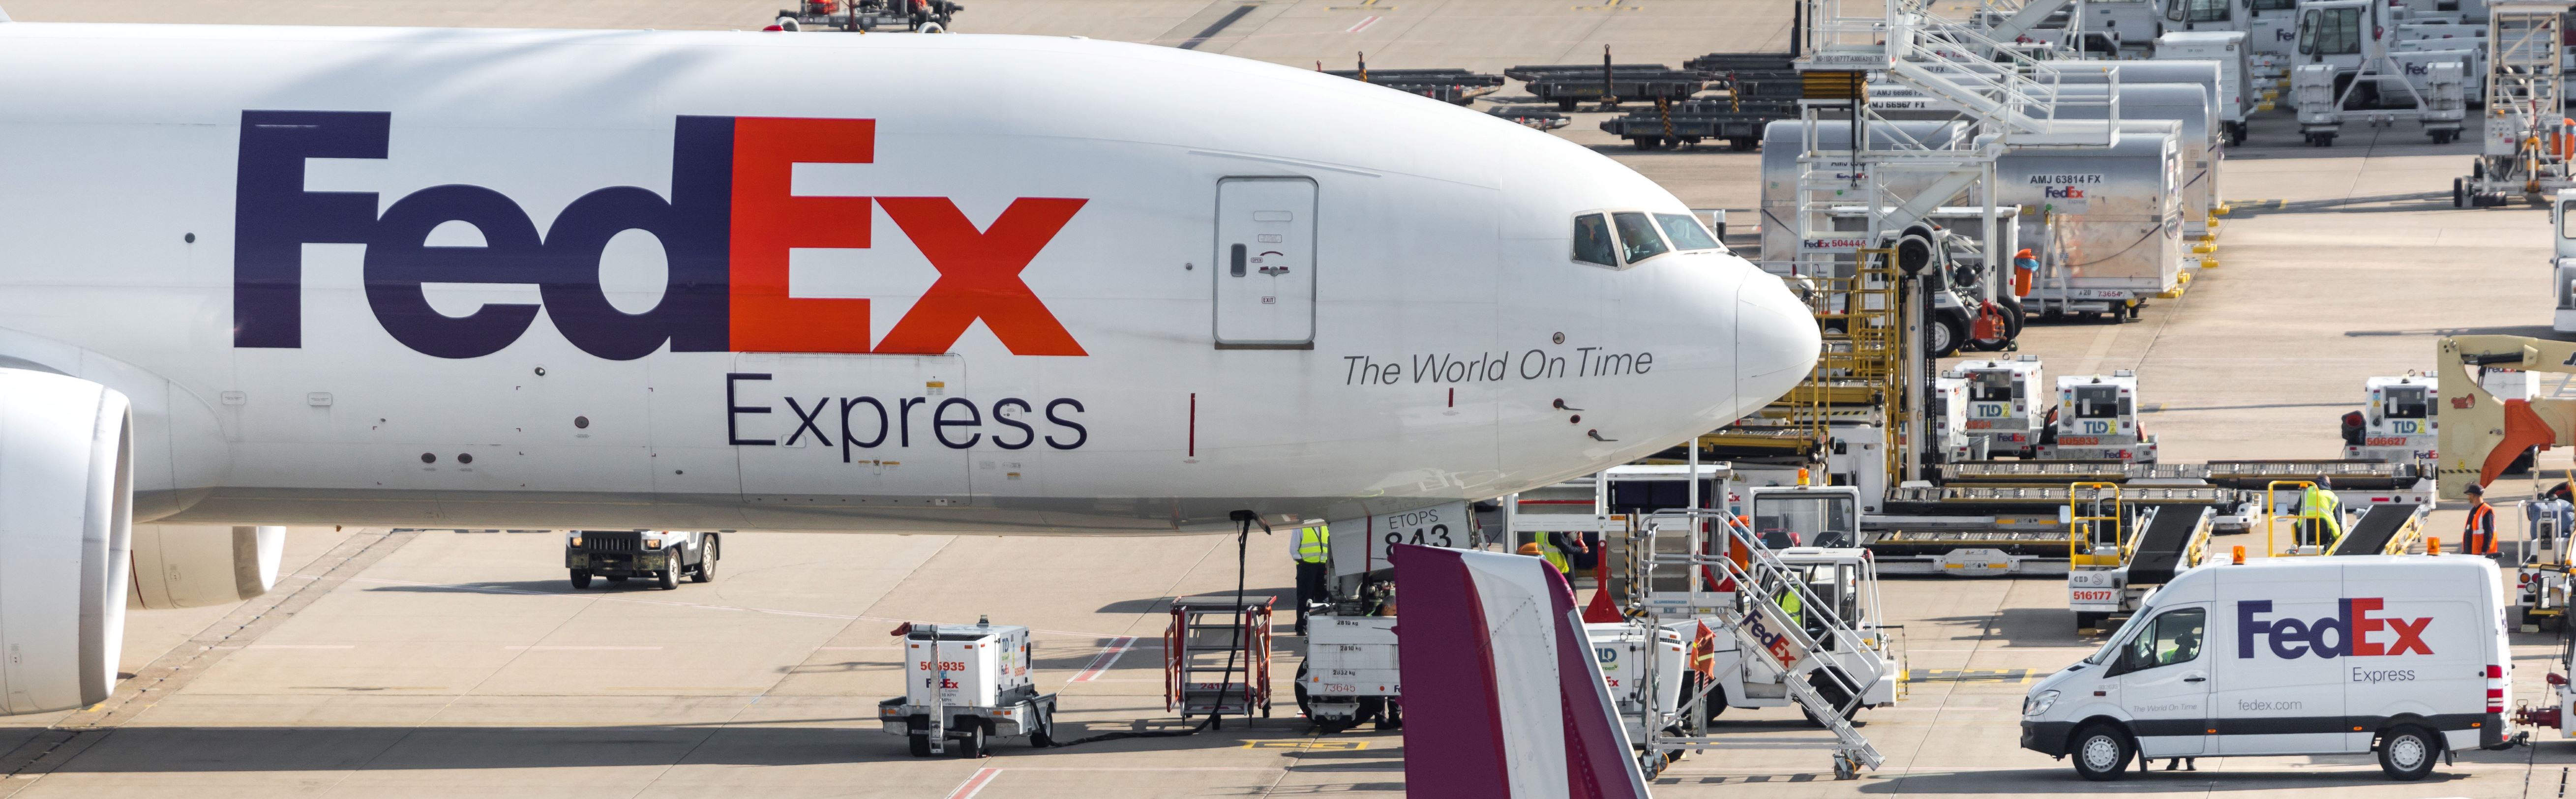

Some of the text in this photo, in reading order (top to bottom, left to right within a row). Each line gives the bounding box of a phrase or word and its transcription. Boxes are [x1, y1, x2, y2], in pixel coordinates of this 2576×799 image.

[2030, 175, 2101, 184] AMJ 63814 FX
[2045, 186, 2084, 198] FedEx
[234, 109, 1089, 361] FedEx
[1804, 239, 1830, 248] FedEx
[1344, 347, 1653, 385] The World On Time
[1978, 404, 2003, 417] TLD
[726, 373, 1088, 463] Express
[2084, 421, 2109, 434] TLD
[2393, 420, 2417, 434] TLD
[1997, 433, 2026, 442] FedEx
[2367, 437, 2406, 446] 506627
[2104, 450, 2133, 459] FedEx
[1389, 509, 1438, 530] ETOPS
[1385, 524, 1452, 555] 843
[2073, 591, 2112, 600] 516177
[2237, 597, 2435, 659] FedEx
[1742, 609, 1797, 669] FedEx
[2353, 667, 2415, 684] Express
[926, 679, 959, 688] FdEx
[1324, 683, 1356, 692] 73645
[2238, 699, 2302, 711] fedex.com
